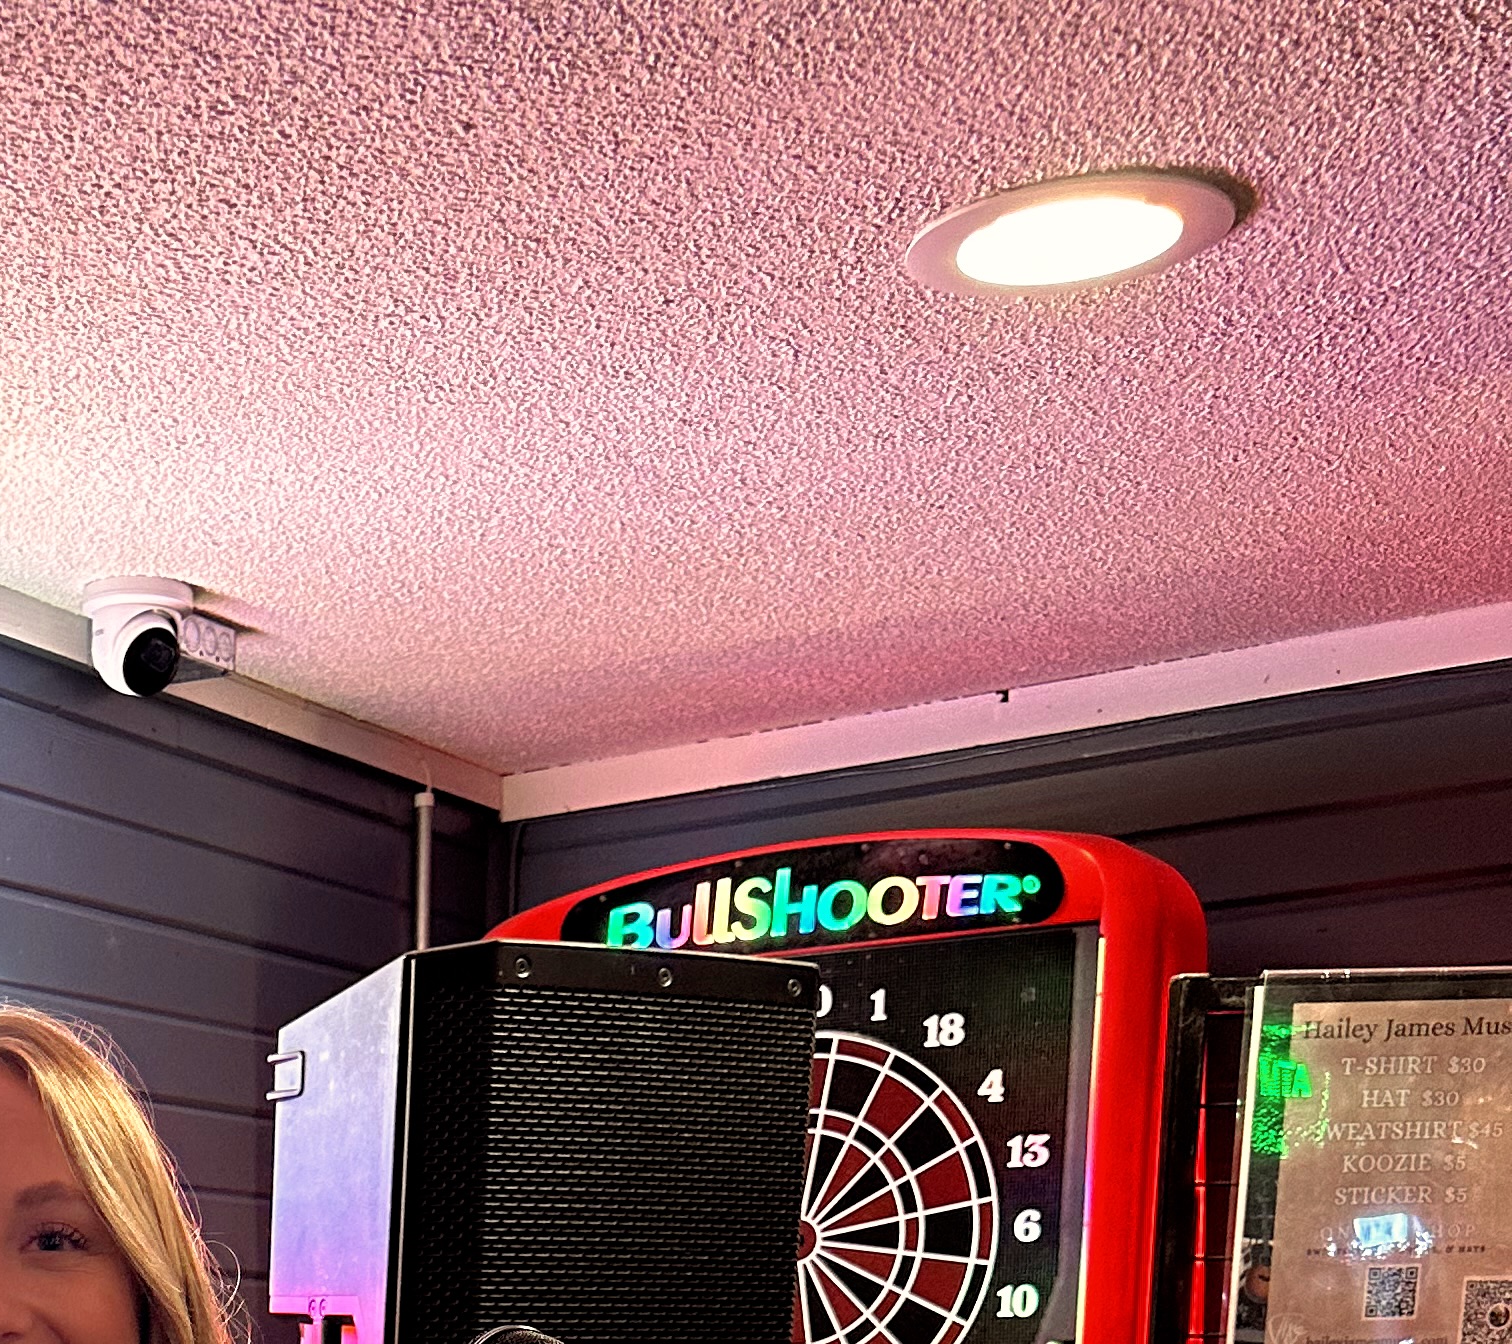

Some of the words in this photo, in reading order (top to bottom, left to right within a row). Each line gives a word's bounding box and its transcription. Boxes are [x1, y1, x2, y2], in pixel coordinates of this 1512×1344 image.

[869, 990, 889, 1022] 1
[922, 1012, 966, 1048] 18
[1304, 1020, 1379, 1043] Hailey
[1384, 1018, 1455, 1041] James
[1341, 1056, 1438, 1076] T-SHIRT
[1446, 1056, 1487, 1075] $30
[976, 1068, 1006, 1103] 4
[1361, 1089, 1412, 1108] HAT
[1420, 1089, 1460, 1108] $30
[1467, 1120, 1503, 1139] $45
[1006, 1133, 1052, 1169] 13
[1342, 1154, 1433, 1174] KOOZIE
[1443, 1153, 1467, 1172] $5
[1334, 1186, 1433, 1207] STICKER
[1444, 1186, 1468, 1204] $5
[1012, 1208, 1042, 1242] 6
[995, 1285, 1040, 1319] 10
